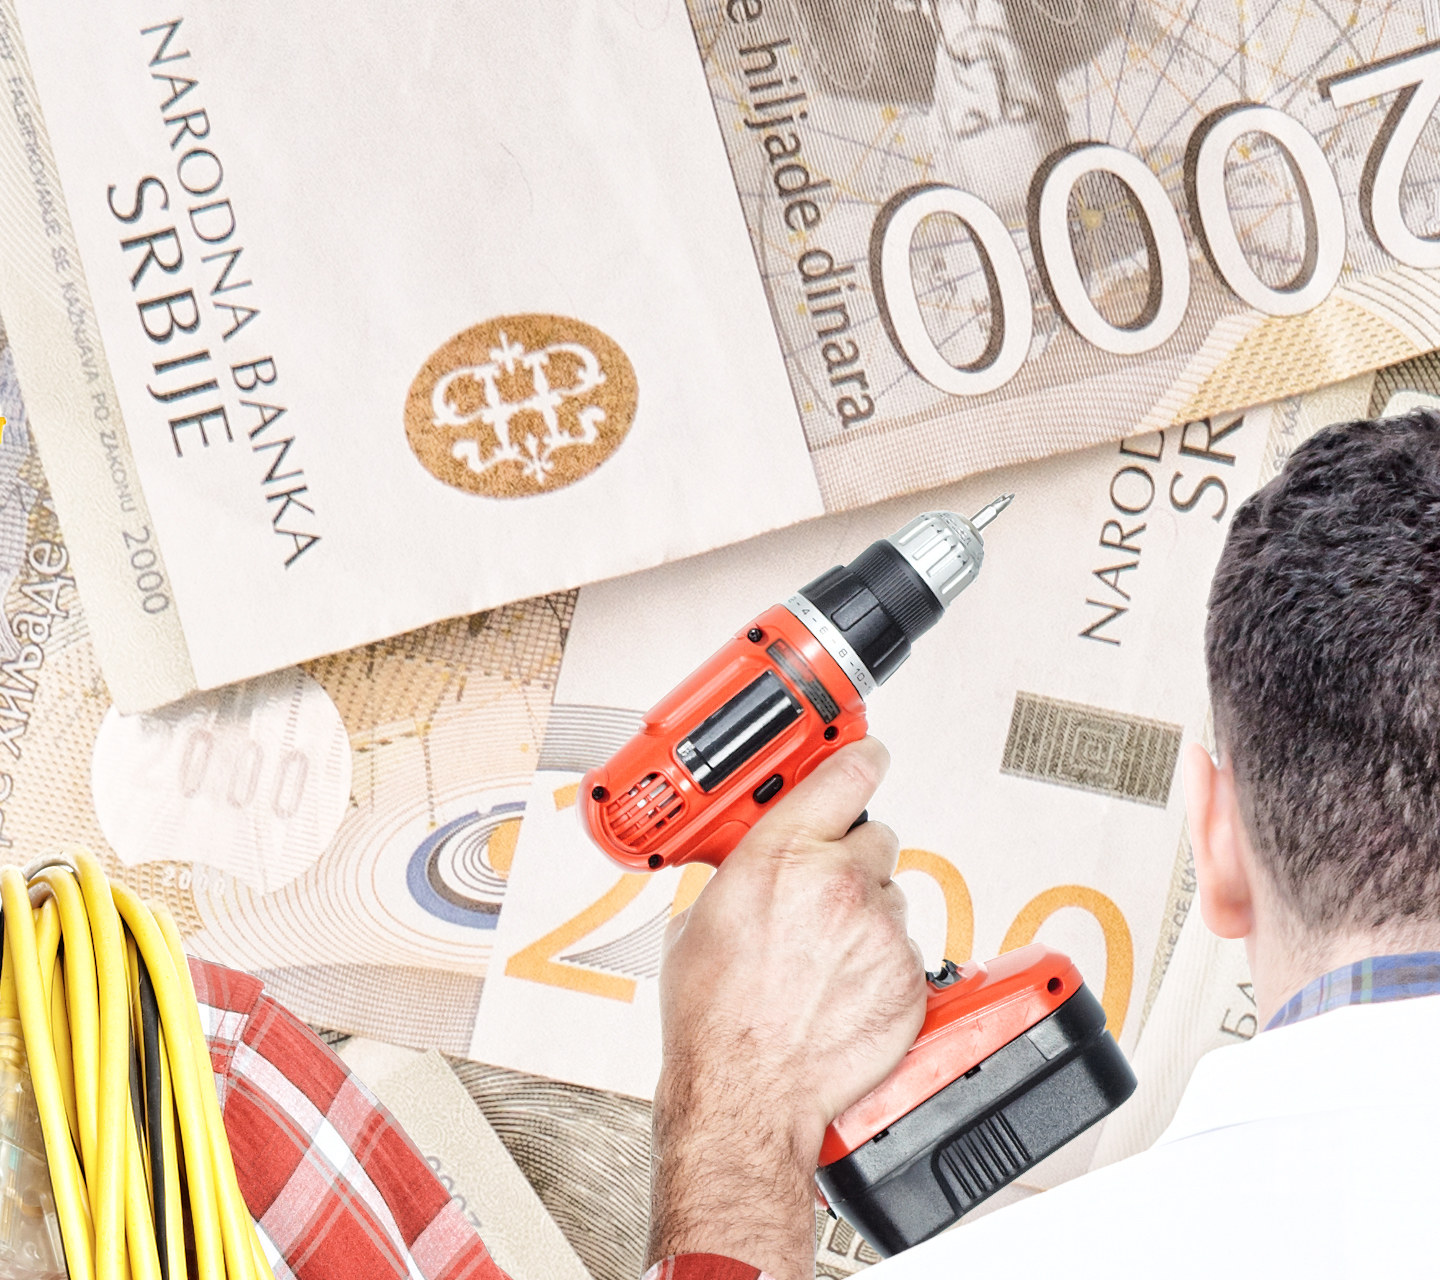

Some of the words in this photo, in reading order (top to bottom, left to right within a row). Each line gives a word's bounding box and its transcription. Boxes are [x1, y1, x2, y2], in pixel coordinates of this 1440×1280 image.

[106, 174, 235, 459] SRBIJE
[139, 16, 261, 343] NARODNA
[229, 354, 323, 571] BANKA
[738, 36, 833, 234] hiljade
[796, 247, 877, 431] dinara
[90, 391, 109, 422] PO
[98, 429, 136, 514] ZAKONU
[121, 523, 171, 617] 2000
